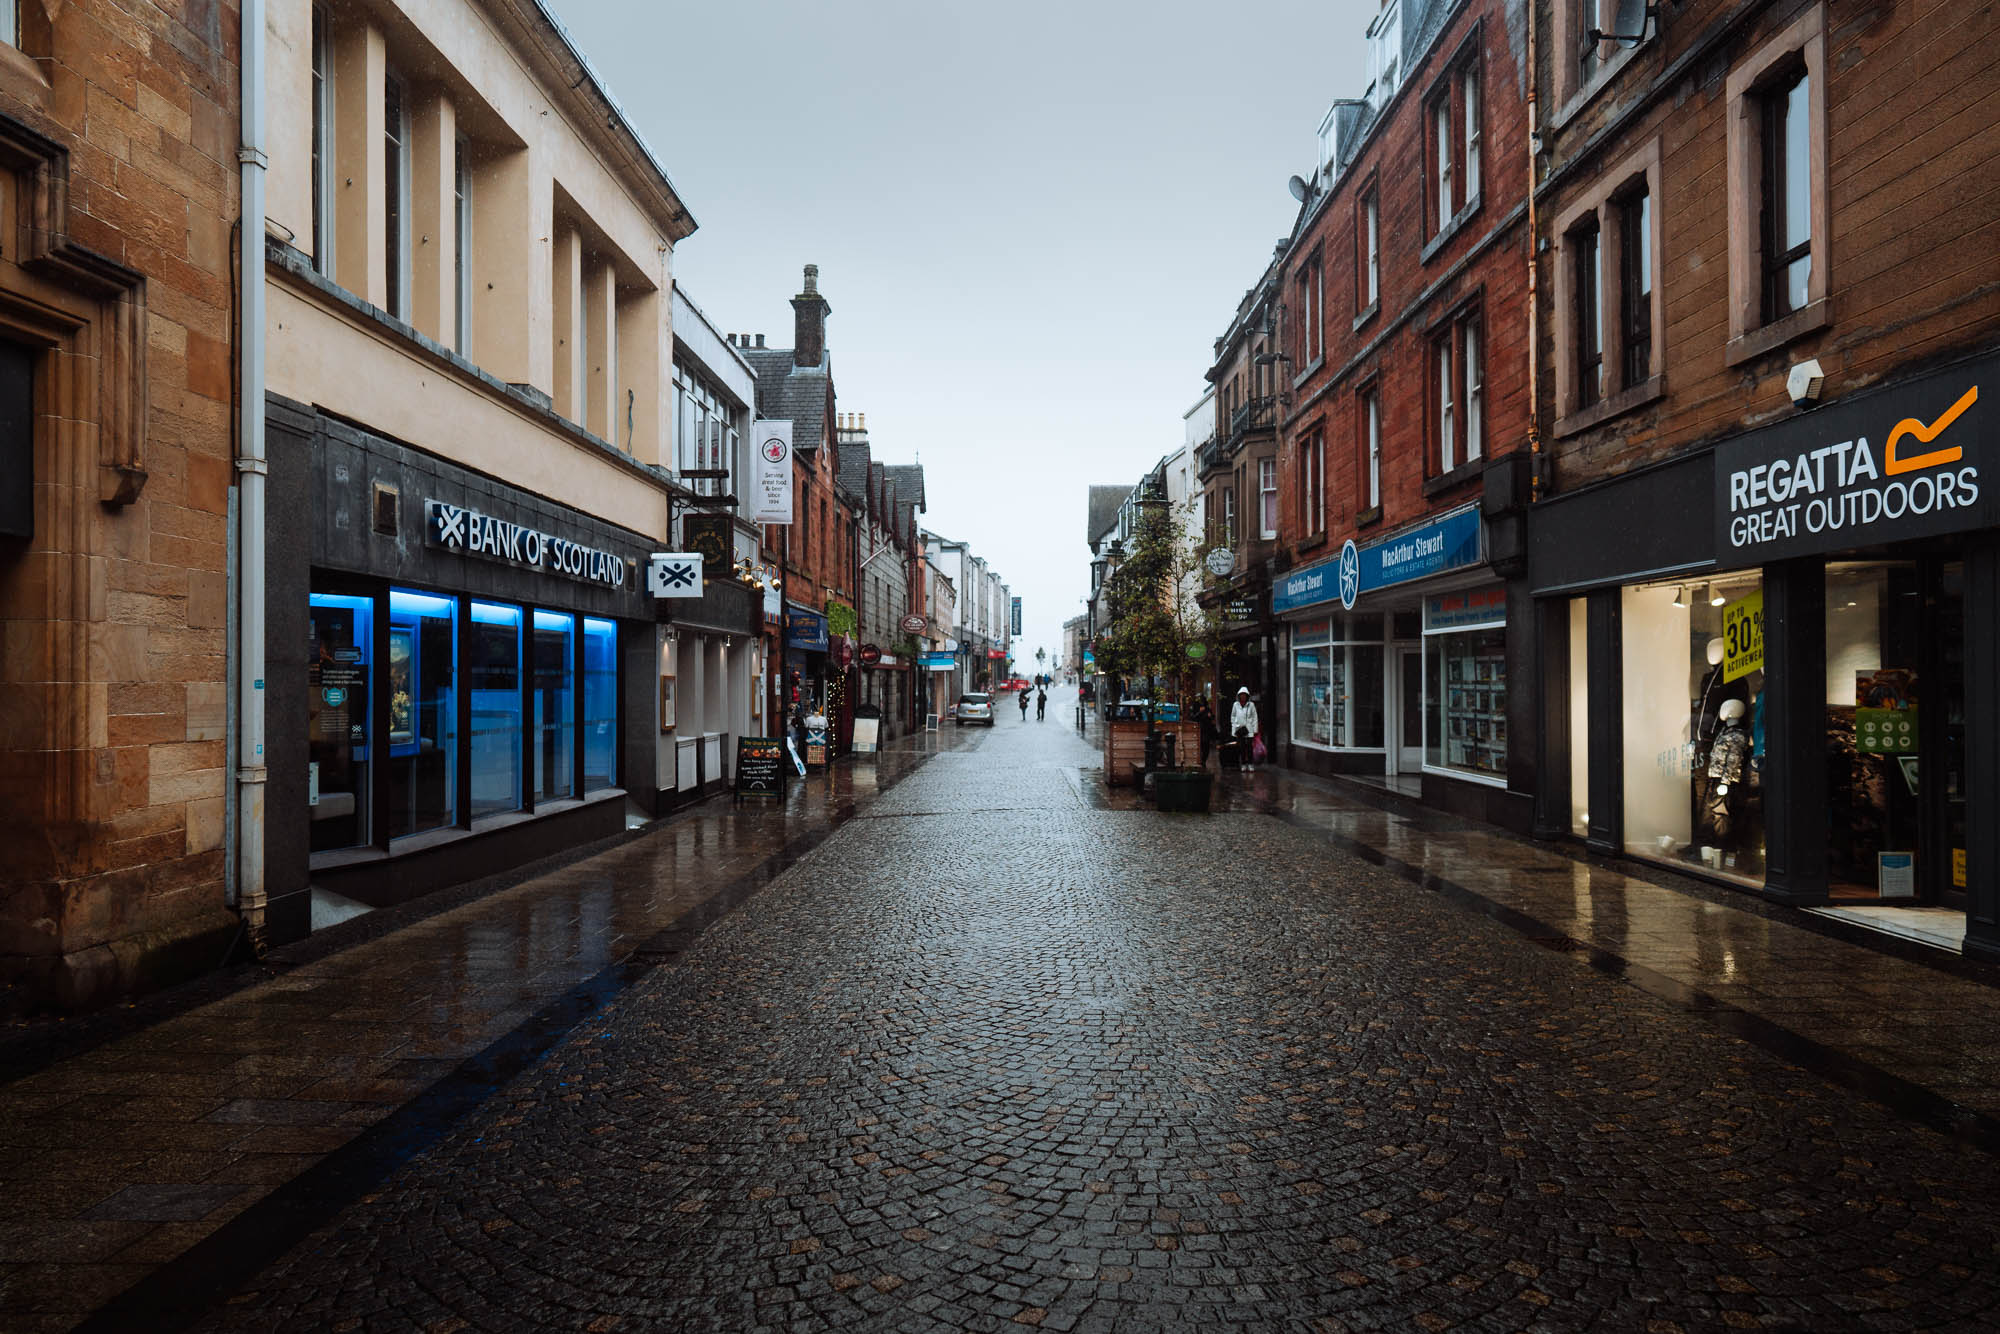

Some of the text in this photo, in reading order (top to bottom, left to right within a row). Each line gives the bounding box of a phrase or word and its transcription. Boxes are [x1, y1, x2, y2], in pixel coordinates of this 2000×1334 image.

[1730, 437, 1879, 512] REGATTA
[1730, 466, 1979, 547] GREAT OUTDOORS
[469, 513, 624, 586] BANK OF SCOTLAND
[1382, 531, 1443, 568] MacArthur Stewart
[1409, 561, 1425, 573] ESTATE
[1287, 579, 1306, 596] MacArthur
[1307, 574, 1323, 591] Stewart
[1736, 606, 1744, 619] TO
[1727, 649, 1762, 673] ACTIVEWEA
